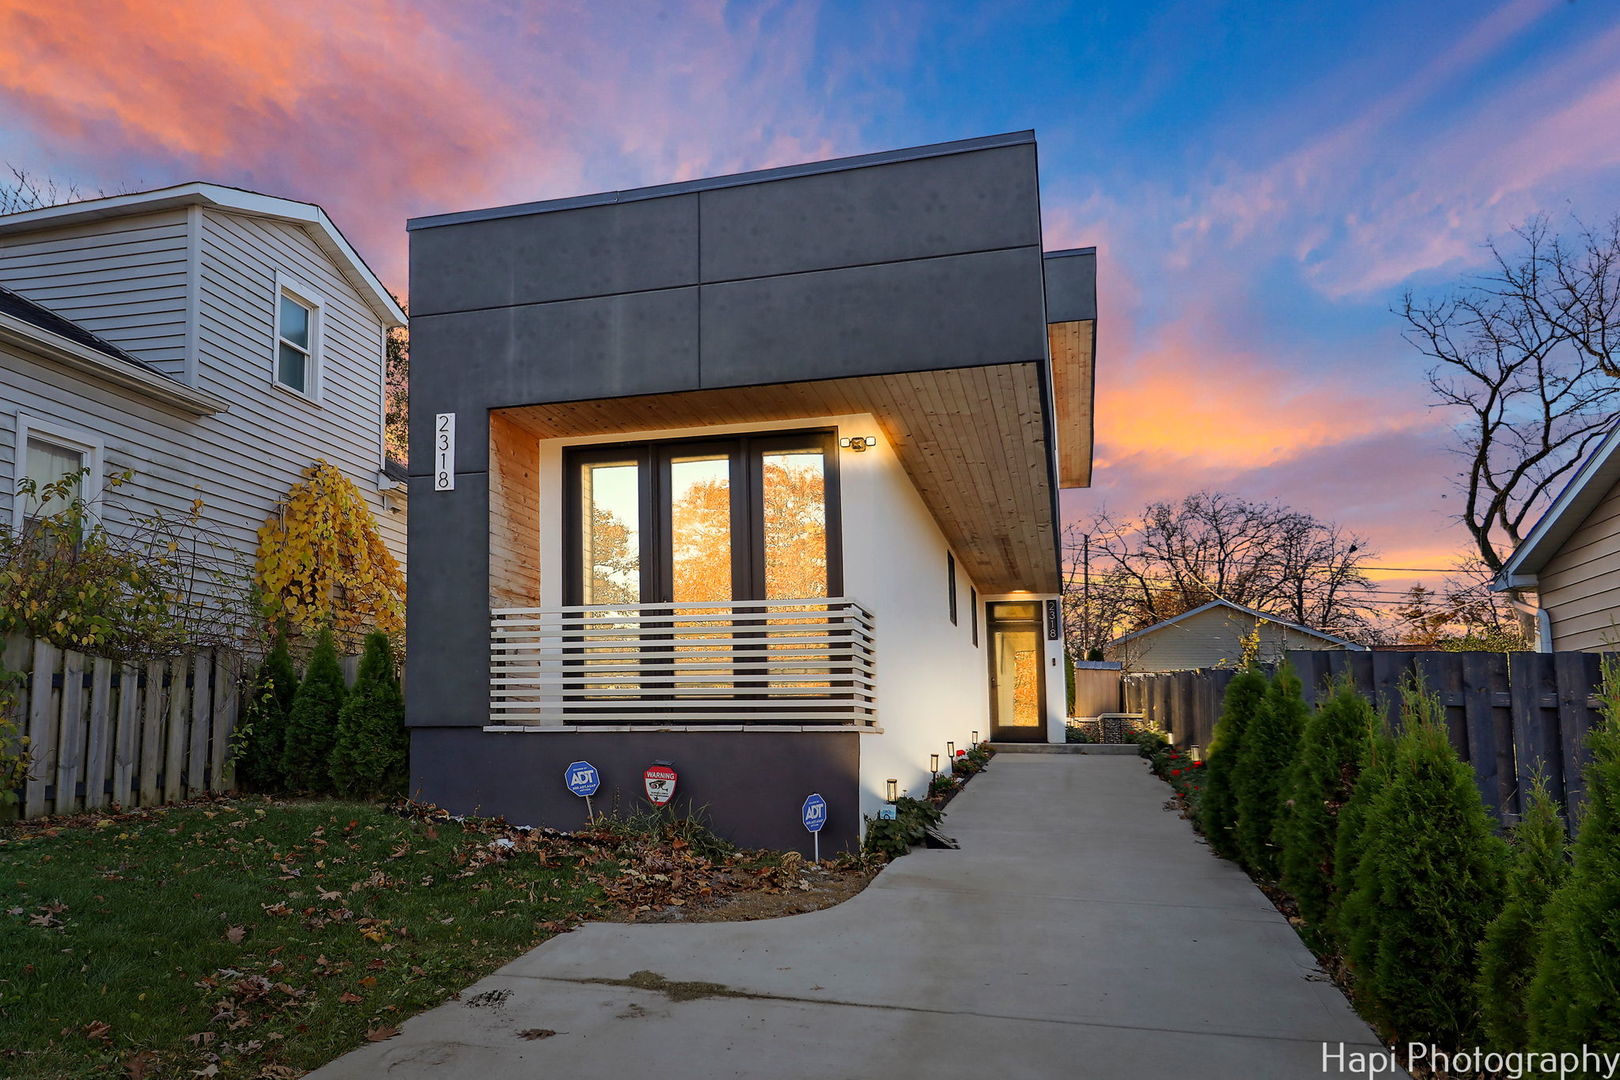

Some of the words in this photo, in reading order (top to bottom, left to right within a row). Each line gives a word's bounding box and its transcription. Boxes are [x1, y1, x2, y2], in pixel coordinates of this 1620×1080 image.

[438, 415, 449, 488] 2318
[571, 769, 594, 786] ADT
[647, 771, 675, 780] WARNING
[805, 803, 824, 820] ADT
